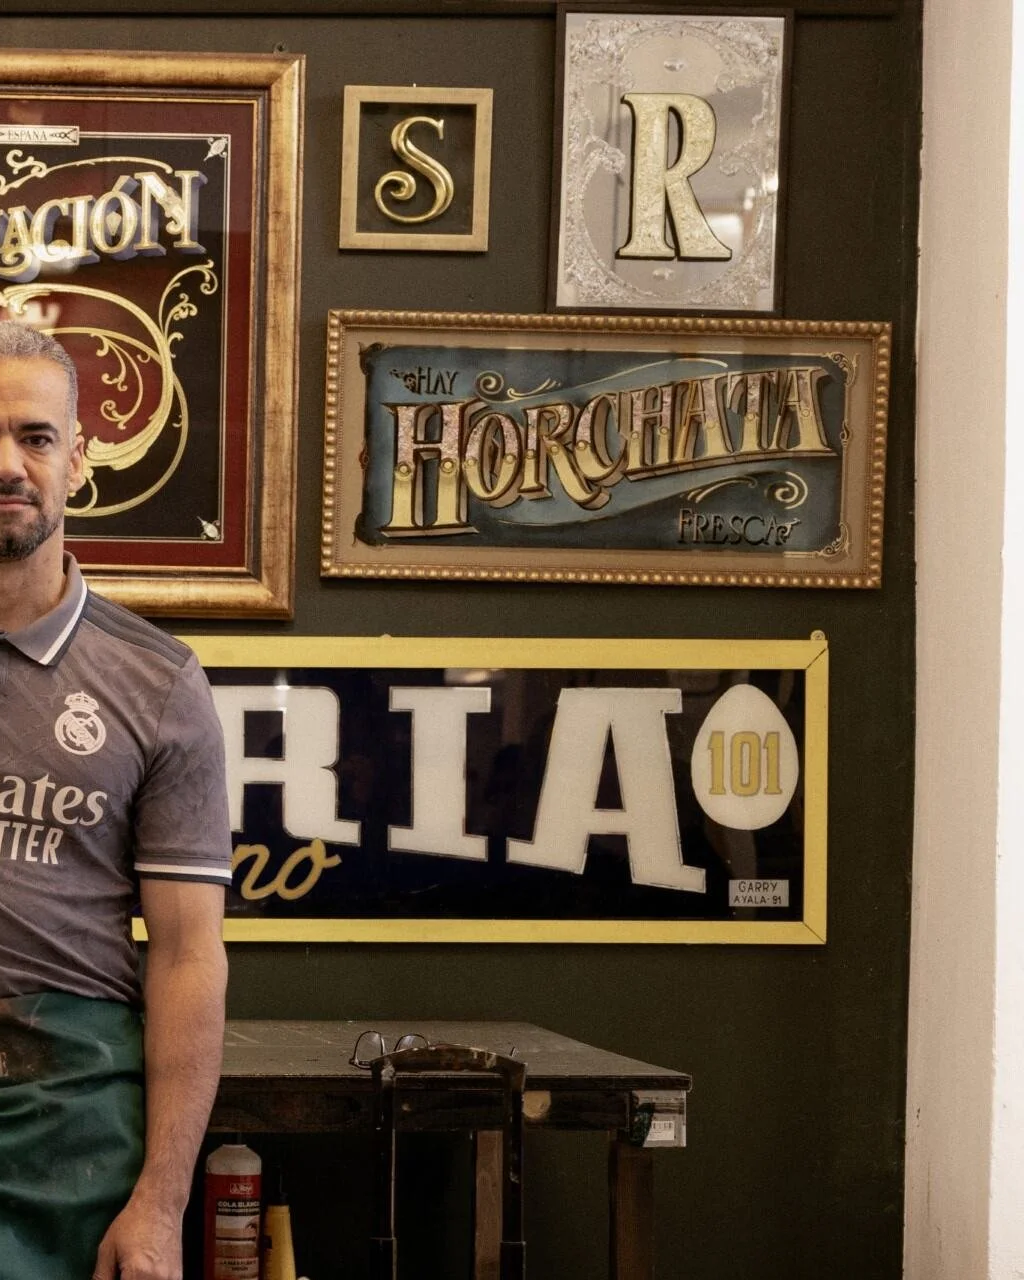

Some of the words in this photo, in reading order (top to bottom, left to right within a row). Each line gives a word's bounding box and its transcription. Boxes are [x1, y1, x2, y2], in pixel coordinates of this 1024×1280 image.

[375, 116, 454, 224] S
[616, 92, 733, 260] R
[414, 366, 460, 395] HAY
[380, 366, 837, 538] HORCHATA
[678, 508, 792, 546] FRESCA
[708, 730, 784, 796] 101
[738, 881, 777, 893] GARRY
